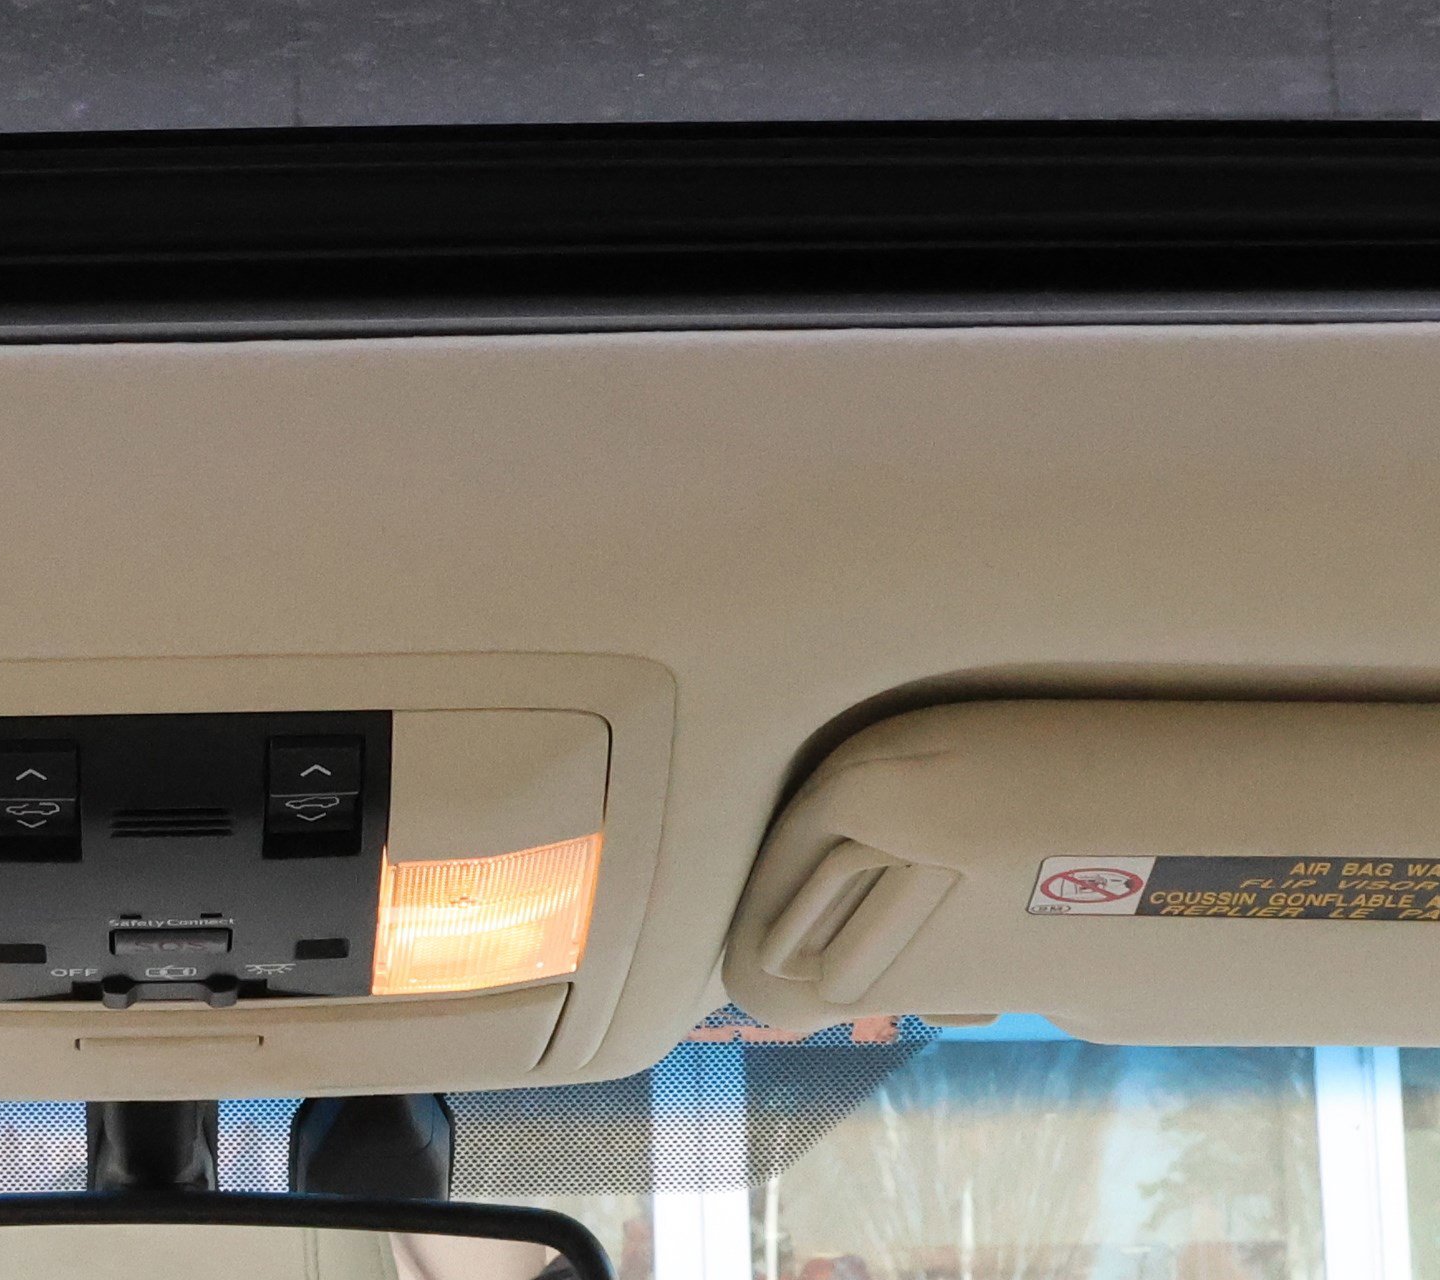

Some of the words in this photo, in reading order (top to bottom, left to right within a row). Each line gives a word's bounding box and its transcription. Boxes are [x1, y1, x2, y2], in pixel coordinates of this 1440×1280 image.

[1288, 862, 1331, 876] AIR
[1340, 863, 1395, 877] BAG
[1239, 879, 1318, 889] FLIP
[1336, 880, 1438, 891] VISOR
[1148, 891, 1257, 905] COUSSIN
[1267, 893, 1414, 908] GONFLABLE
[1160, 905, 1303, 916] REPLIER
[1329, 908, 1373, 917] LE
[109, 919, 163, 928] Safety
[166, 917, 234, 926] Connect
[50, 969, 99, 977] OFF
